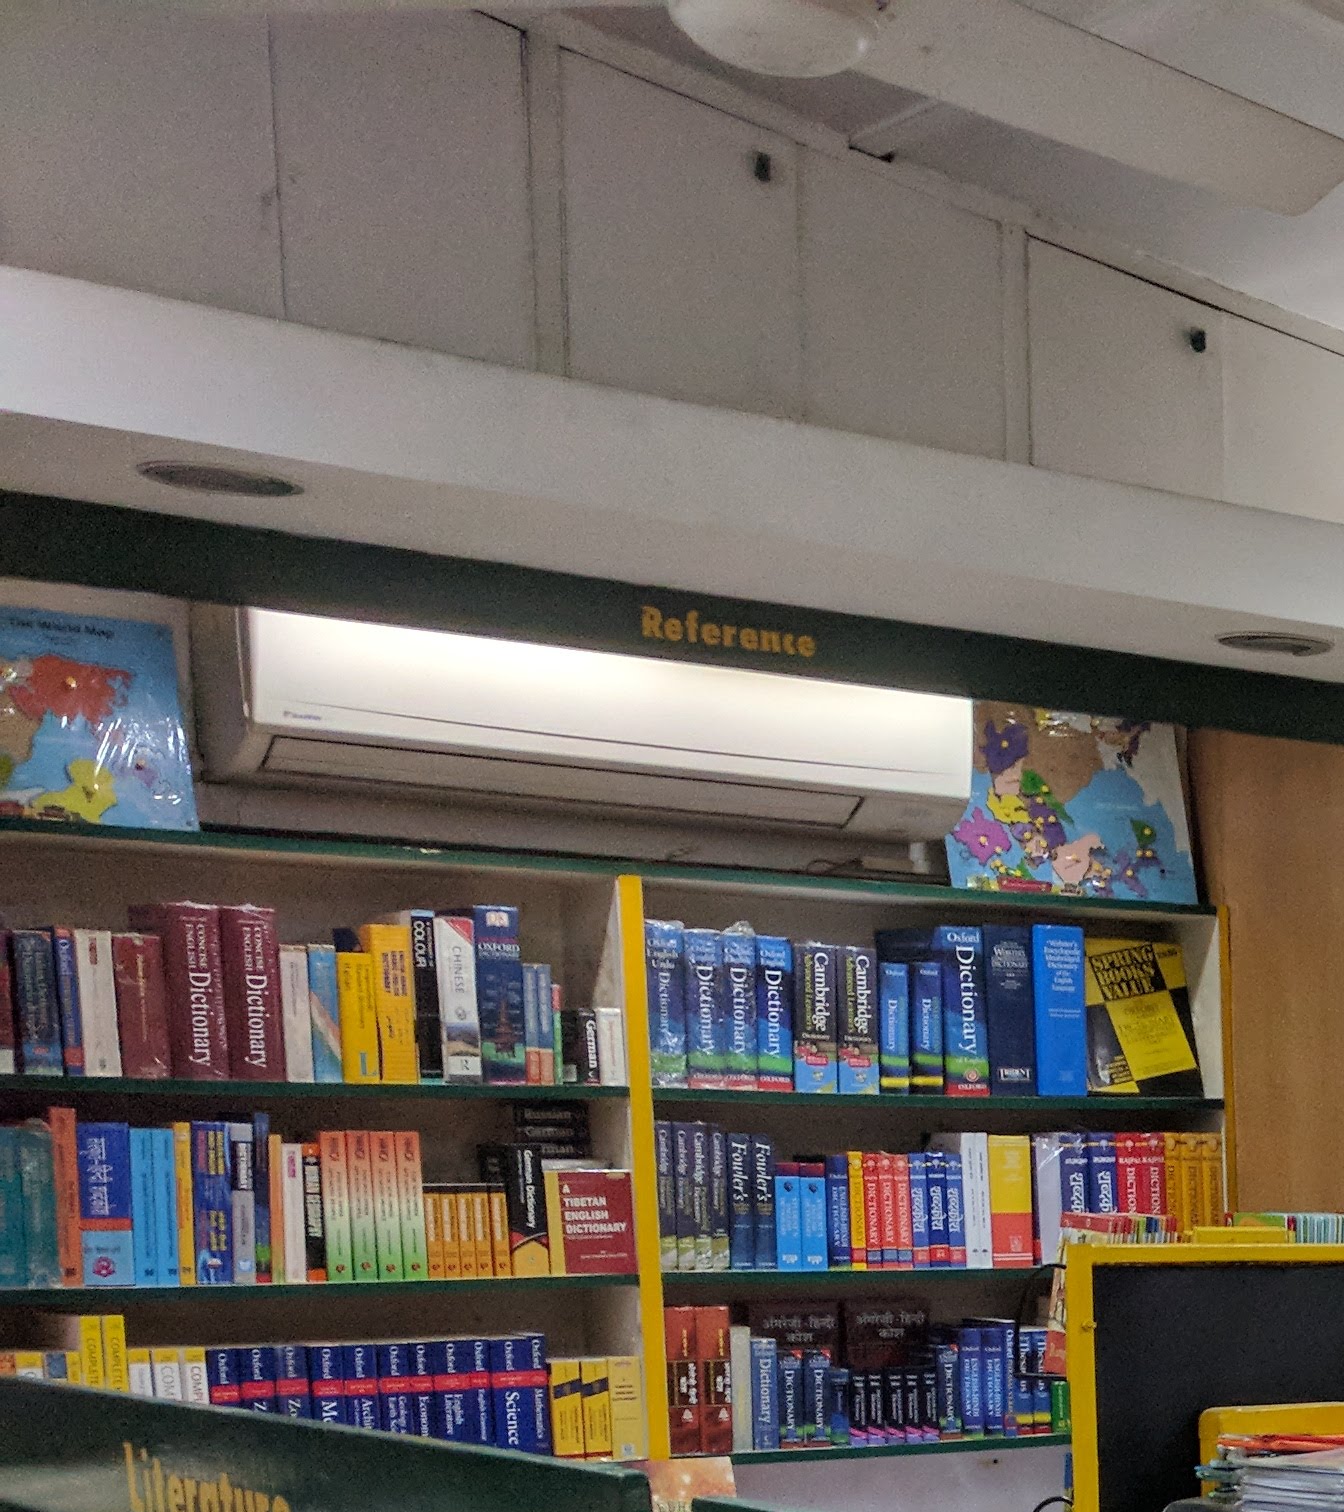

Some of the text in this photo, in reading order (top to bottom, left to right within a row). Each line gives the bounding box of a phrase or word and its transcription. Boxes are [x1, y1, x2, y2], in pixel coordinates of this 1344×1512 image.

[641, 604, 816, 658] Reference
[947, 932, 980, 943] Oxford
[1091, 945, 1152, 972] SPRING
[451, 945, 465, 994] CHINESE
[812, 952, 831, 1033] Cambridge
[854, 955, 873, 1035] Cambridge
[1096, 963, 1157, 987] BOOKS
[1100, 980, 1155, 1001] VALUE
[188, 971, 212, 1067] Dictionary
[245, 974, 269, 1068] Dictionary
[696, 965, 716, 1055] Dictionary
[729, 966, 748, 1055] Dictionary
[764, 969, 783, 1059] Dictionary
[887, 1000, 899, 1051] Dictionary
[921, 998, 933, 1050] Dictionary
[955, 945, 979, 1056] Dictionary
[584, 1019, 598, 1070] German
[731, 1141, 750, 1202] Fowler's
[755, 1142, 772, 1202] Fowler's
[564, 1196, 607, 1207] TIBETAN
[565, 1210, 609, 1221] ENGLISH
[565, 1222, 627, 1234] DICTIONARY
[1006, 1329, 1014, 1359] Oxford
[759, 1359, 771, 1423] Dictionary
[505, 1391, 519, 1446] Science
